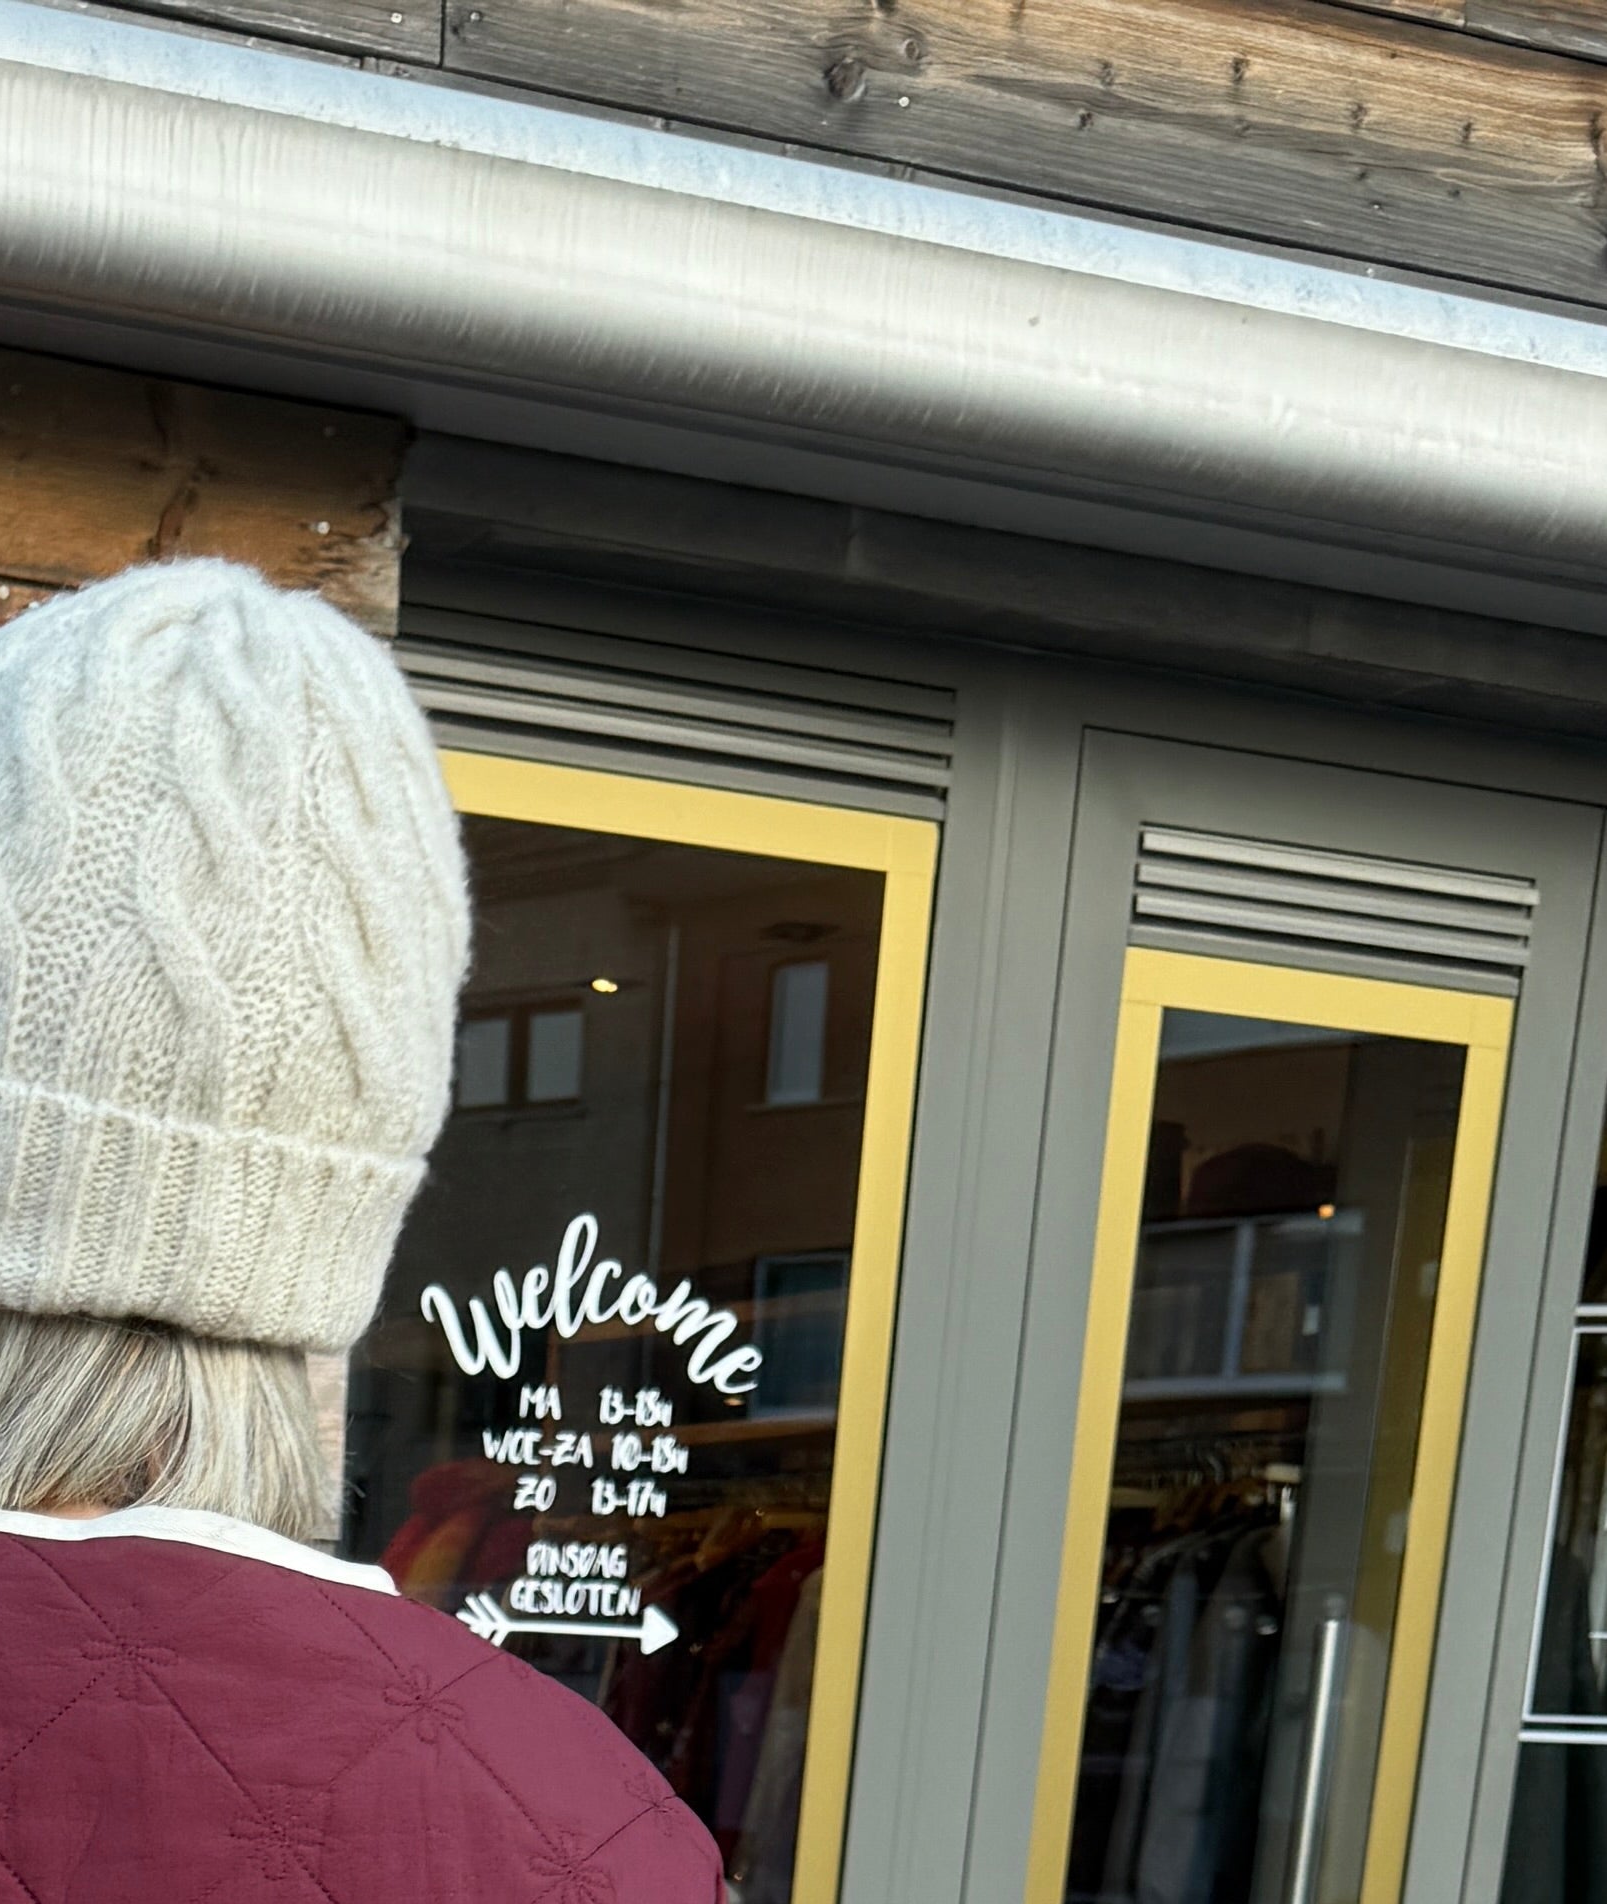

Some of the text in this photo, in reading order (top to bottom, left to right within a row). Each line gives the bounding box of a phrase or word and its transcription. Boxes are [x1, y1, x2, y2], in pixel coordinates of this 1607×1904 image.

[420, 1213, 763, 1394] Welcome
[519, 1384, 562, 1421] MA
[482, 1428, 594, 1469] WOE-ZA
[513, 1475, 557, 1512] ZO
[526, 1540, 627, 1579] DINSDAG
[509, 1577, 642, 1617] GESLOTEN
